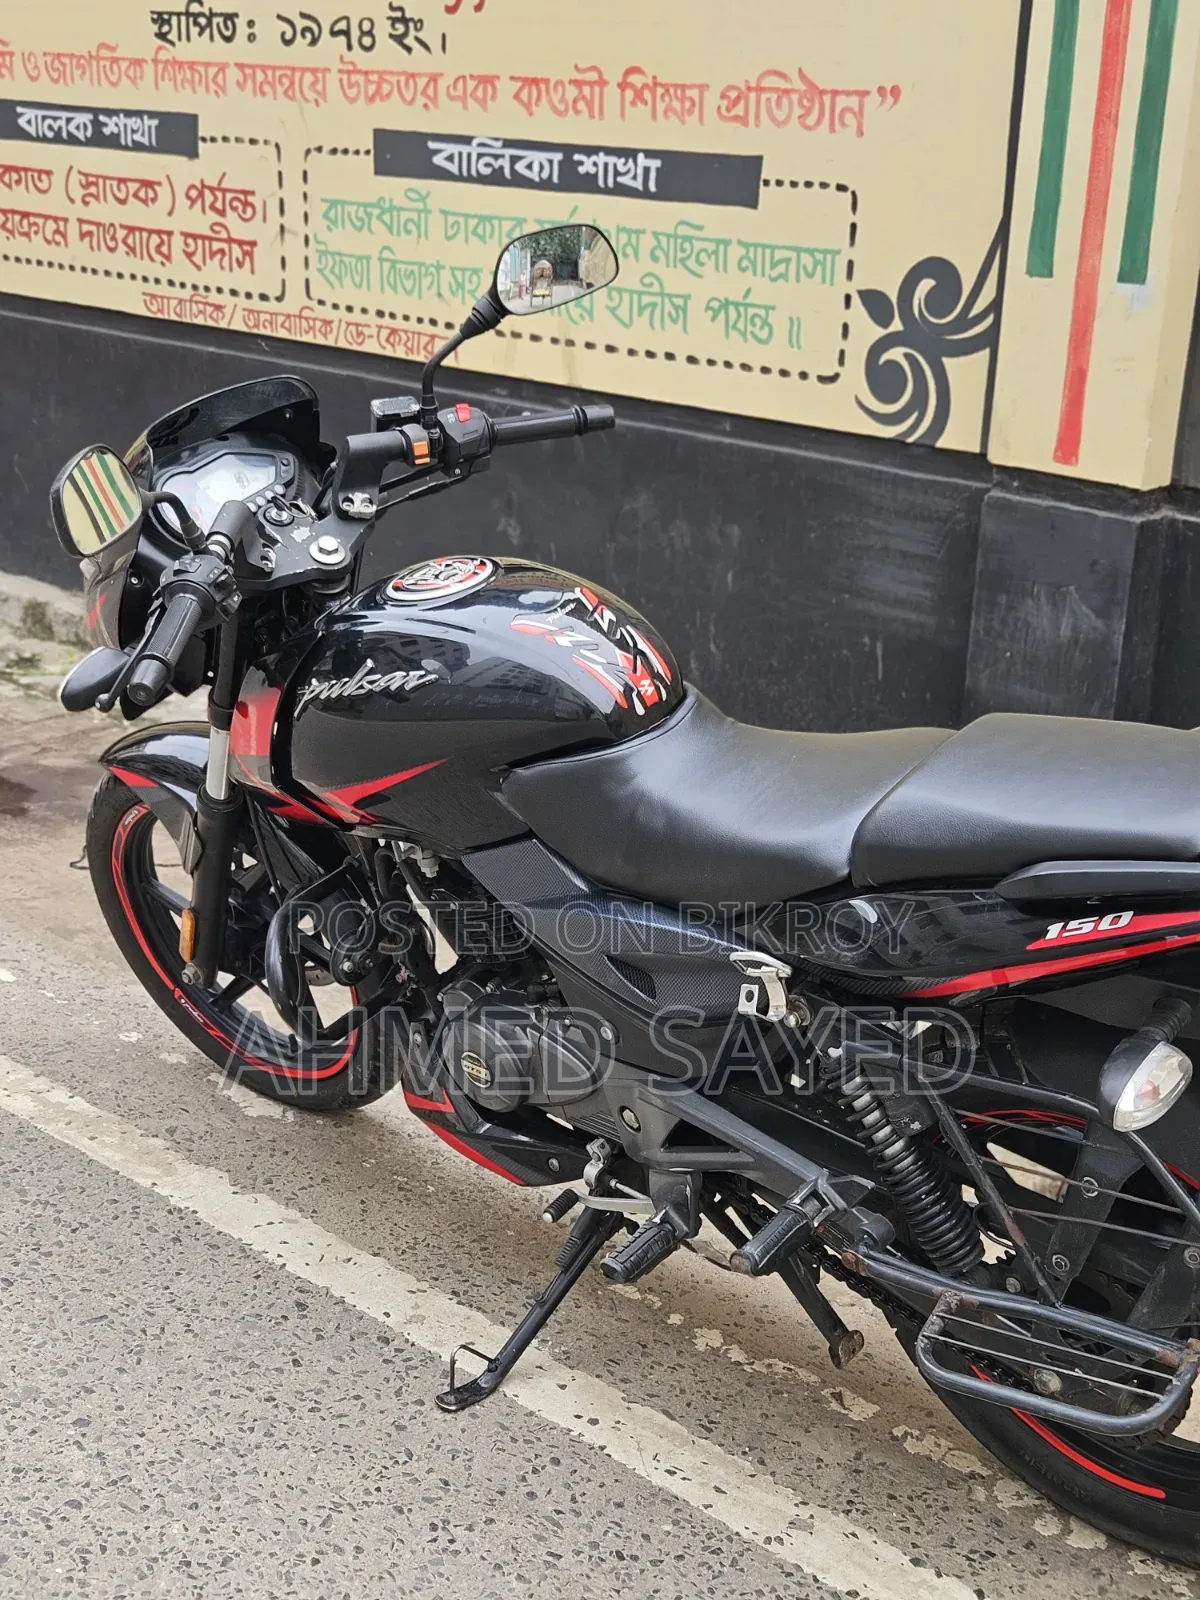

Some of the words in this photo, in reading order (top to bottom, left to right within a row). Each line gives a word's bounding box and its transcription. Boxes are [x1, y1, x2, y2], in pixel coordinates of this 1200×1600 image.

[276, 10, 376, 52] ১৯৭৪
[22, 51, 41, 82] ও
[43, 42, 148, 91] জাগতিক
[151, 44, 230, 98] শিক্ষার
[234, 62, 331, 107] সমন্বয়ে
[337, 54, 444, 112] উচ্চতর
[446, 73, 500, 112] এক
[509, 63, 610, 120] কওমী
[616, 65, 710, 126] শিক্ষা
[16, 106, 93, 142] বালক
[99, 113, 159, 147] শাখা
[427, 136, 563, 184] বালিকা
[573, 151, 662, 193] শাখা
[77, 217, 175, 268] দাওরায়ে
[180, 222, 258, 275] হাদীস
[320, 187, 432, 241] রাজধানী
[650, 220, 733, 279] মহিলা
[737, 239, 842, 287] মাদ্রাসা
[605, 271, 692, 335] হাদীস
[704, 287, 776, 346] পর্যন্ত
[293, 658, 440, 721] pulsar
[1045, 910, 1134, 941] 150
